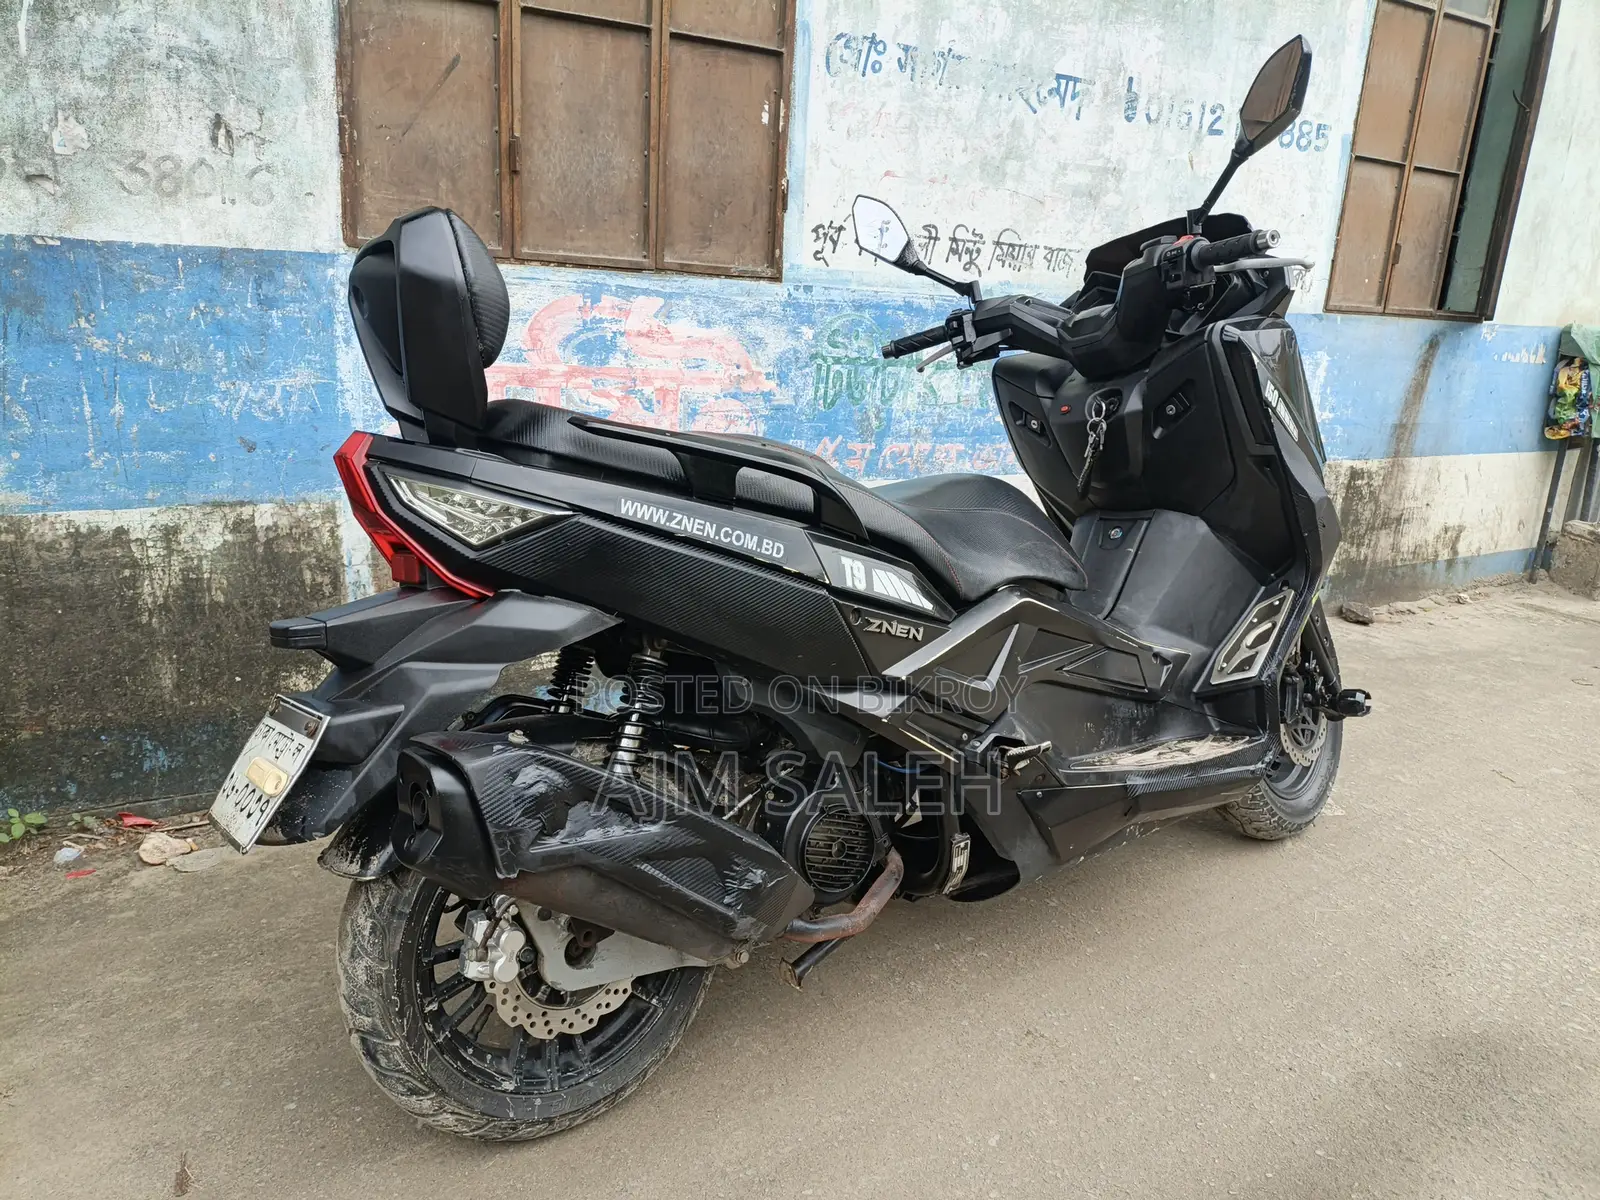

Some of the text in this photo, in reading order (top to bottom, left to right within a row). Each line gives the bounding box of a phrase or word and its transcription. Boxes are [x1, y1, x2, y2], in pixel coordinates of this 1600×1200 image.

[620, 498, 785, 559] WWW.ZNEN.COM.BD
[840, 555, 867, 591] T9
[863, 616, 924, 642] ZNEN
